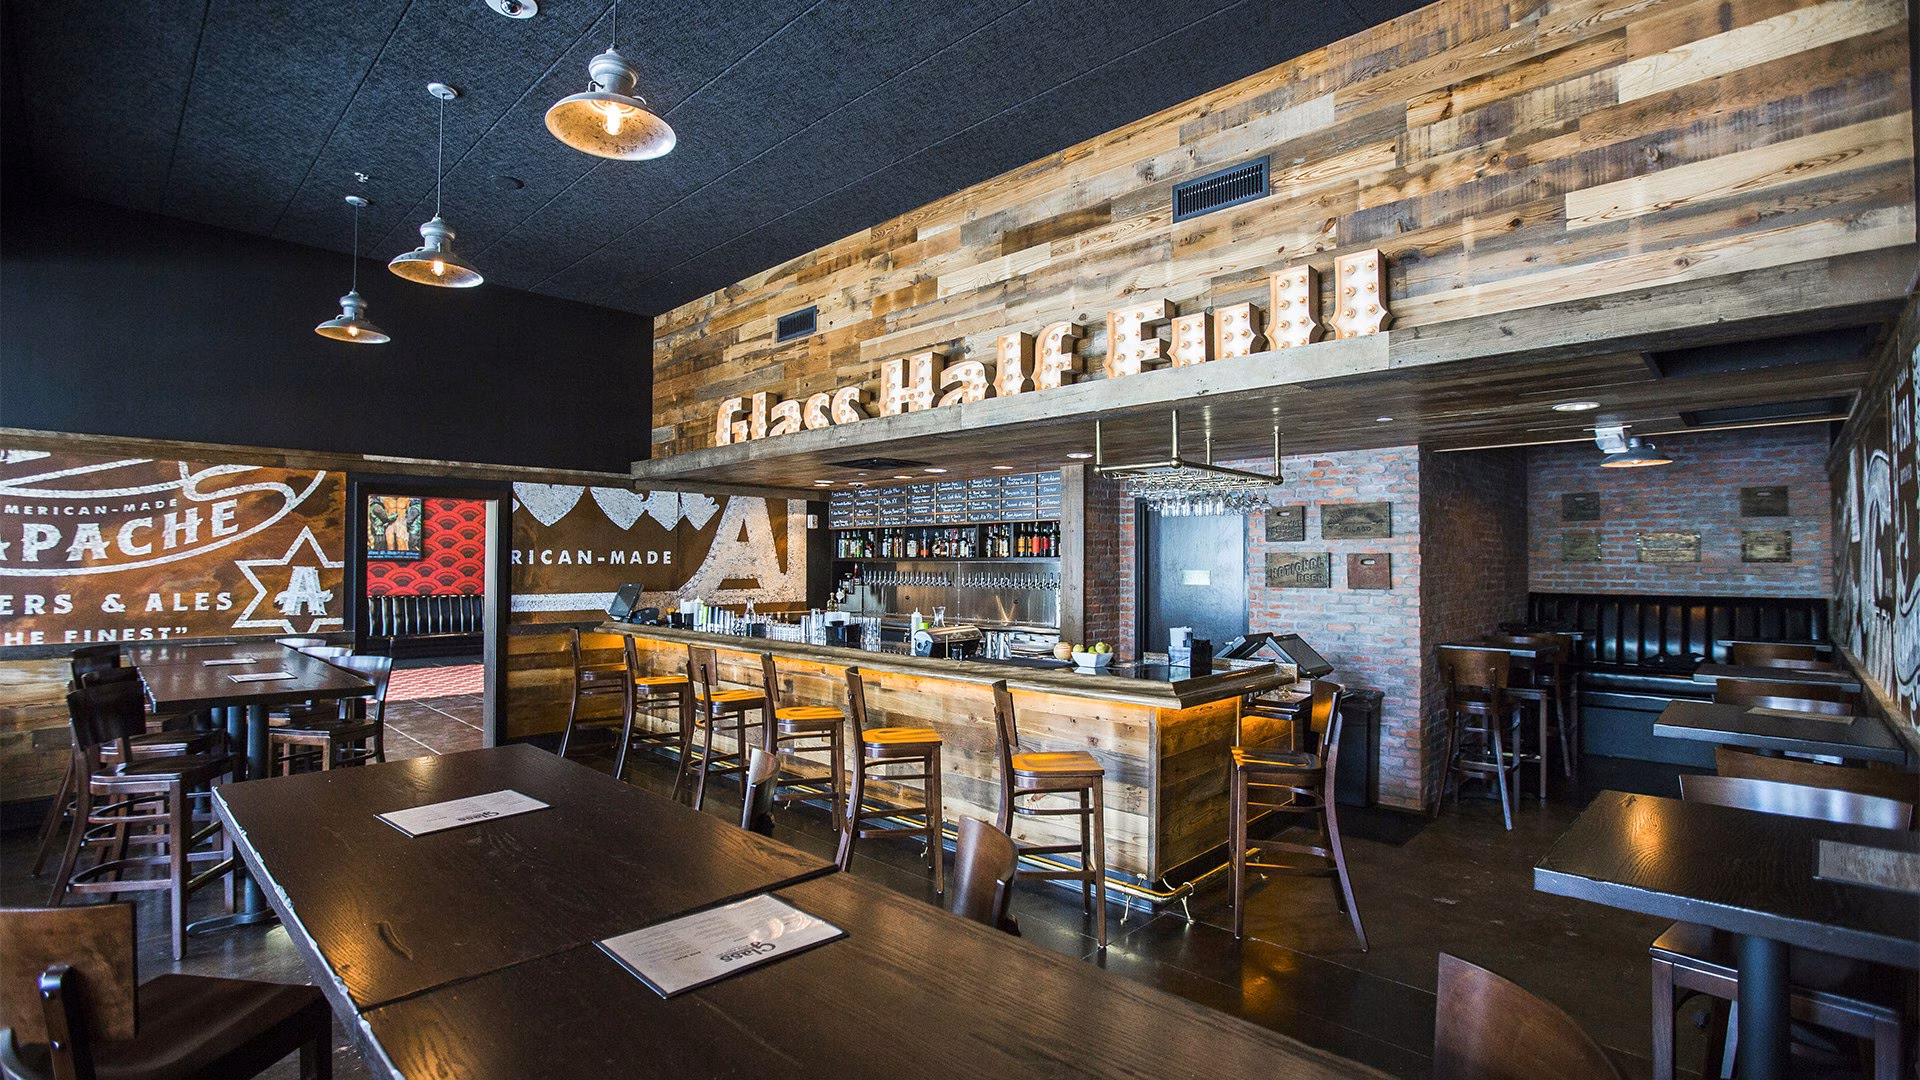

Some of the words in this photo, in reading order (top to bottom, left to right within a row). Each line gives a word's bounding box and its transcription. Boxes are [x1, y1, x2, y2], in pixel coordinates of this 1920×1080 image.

[715, 386, 870, 447] Glass
[878, 329, 1084, 417] Half
[1102, 248, 1394, 379] Full
[0, 499, 239, 562] PACHE
[1270, 557, 1325, 579] NATIONAL
[1296, 573, 1324, 583] BEER
[101, 593, 126, 613] &
[145, 592, 233, 612] ALES
[720, 941, 776, 963] Glass
